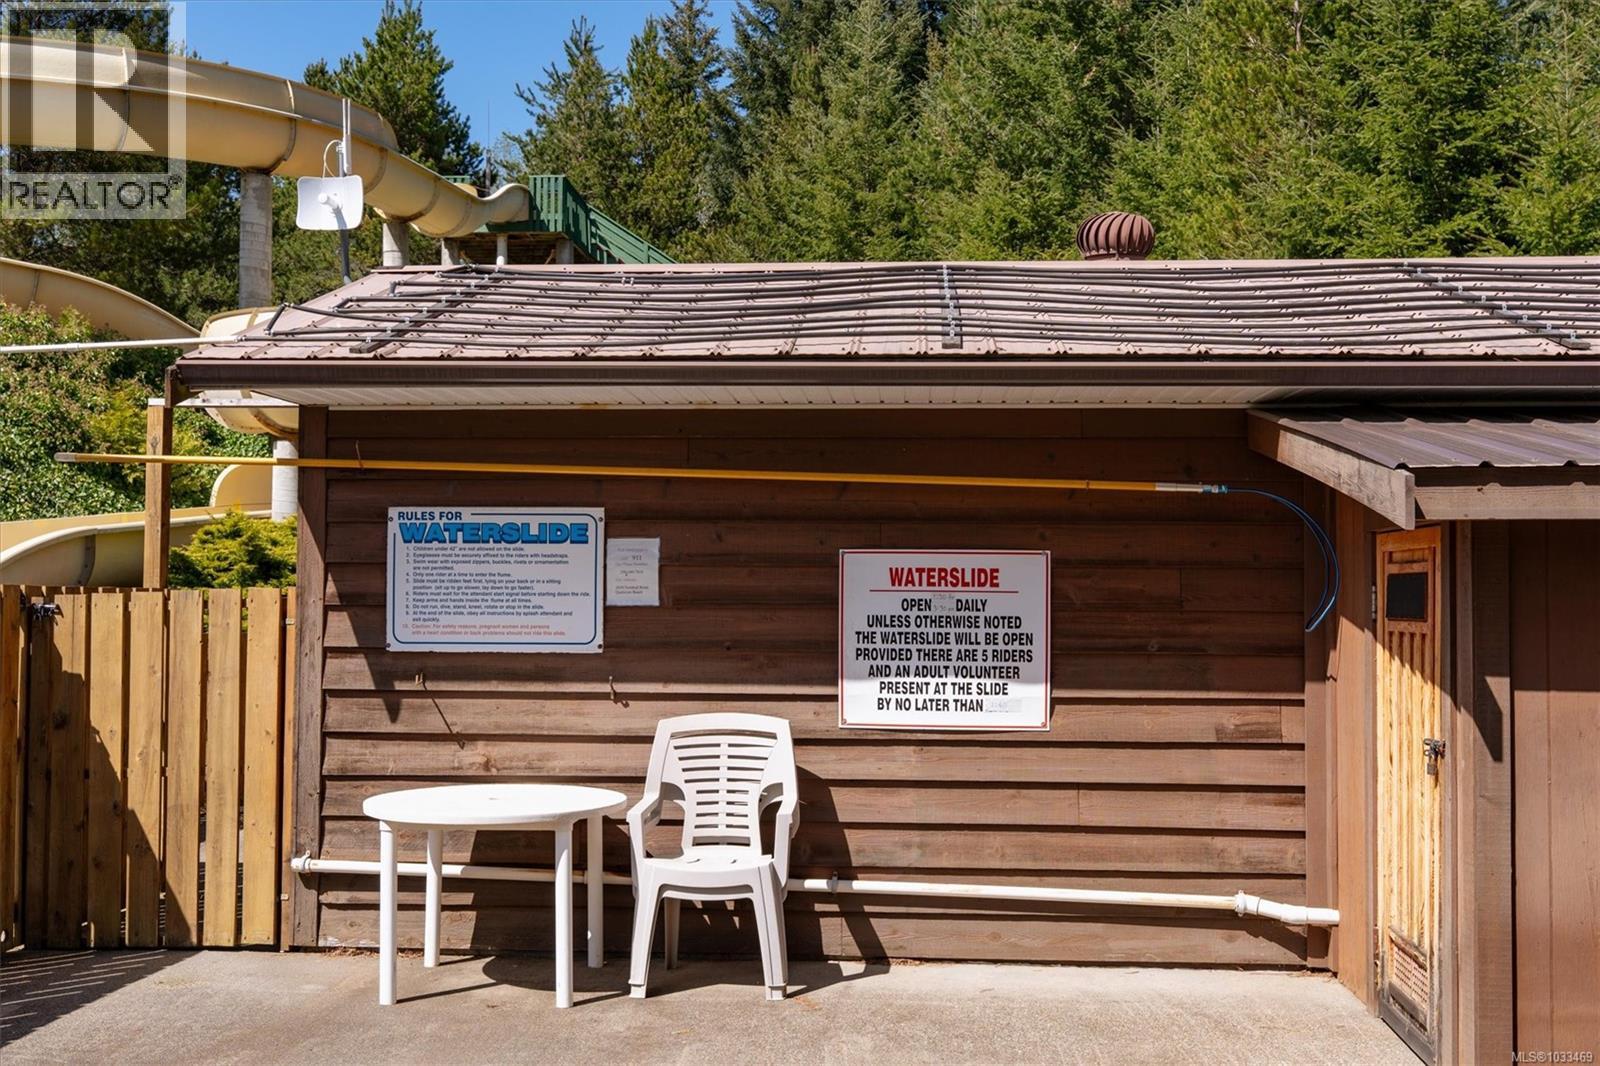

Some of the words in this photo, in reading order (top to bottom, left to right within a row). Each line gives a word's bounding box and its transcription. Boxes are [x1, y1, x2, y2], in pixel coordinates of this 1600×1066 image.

[398, 512, 436, 520] RULES
[439, 512, 462, 520] FOR
[399, 522, 589, 544] WATERSLIDE
[889, 567, 1000, 588] WATERSLIDE
[901, 598, 932, 611] OPEN
[956, 599, 987, 611] DAILY
[867, 615, 911, 628] UNLESS
[915, 615, 980, 629] OTHERWISE
[984, 616, 1022, 629] NOTED
[855, 632, 876, 644] THE
[880, 632, 951, 645] WATERSLIDE
[954, 632, 981, 645] WILL
[985, 633, 999, 645] BE
[1003, 633, 1033, 646] OPEN
[856, 648, 912, 661] PROVIDED
[917, 649, 952, 662] THERE
[956, 649, 978, 662] ARE
[982, 650, 988, 662] 5
[992, 650, 1033, 662] RIDERS
[868, 665, 891, 677] AND
[895, 665, 911, 678] AN
[914, 665, 950, 678] ADULT
[953, 666, 1020, 679] VOLUNTEER
[879, 682, 930, 695] PRESENT
[933, 682, 947, 695] AT
[950, 682, 972, 695] THE
[976, 683, 1008, 695] SLIDE
[877, 698, 891, 710] BY
[895, 698, 911, 711] NO
[915, 699, 950, 711] LATER
[953, 699, 983, 712] THAN
